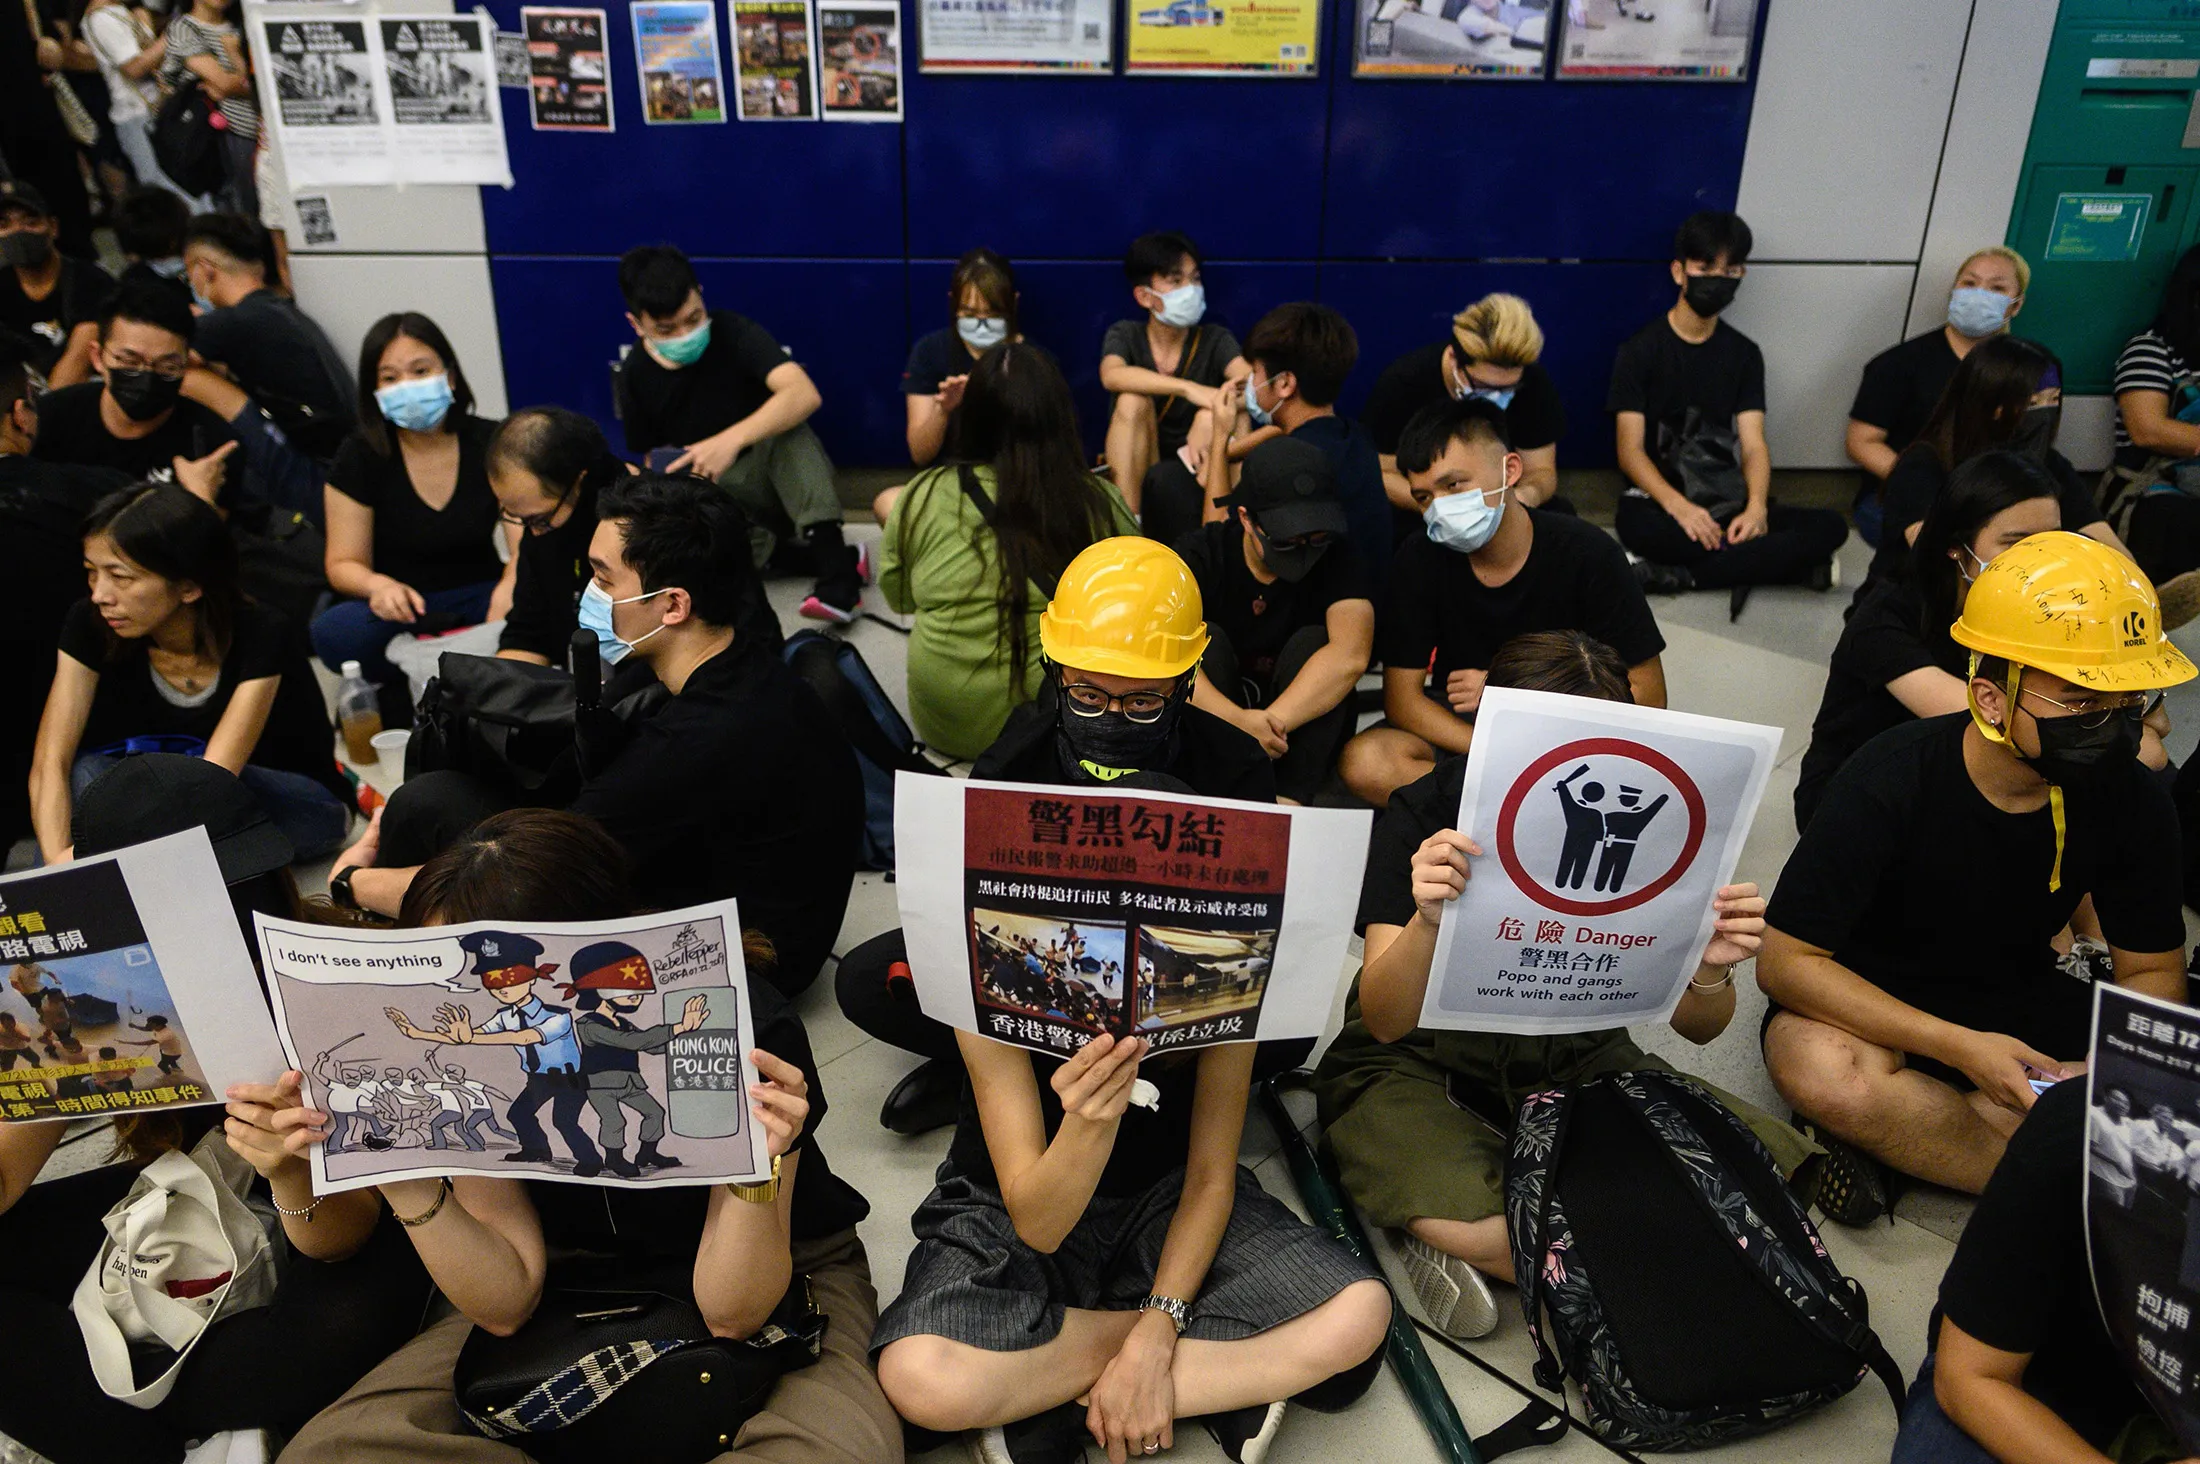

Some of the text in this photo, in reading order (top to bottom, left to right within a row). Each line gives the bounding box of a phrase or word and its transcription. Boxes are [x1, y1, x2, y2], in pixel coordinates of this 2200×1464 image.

[1028, 799, 1225, 859] 警黑勾結
[989, 848, 1270, 886] 市民報警求助超過一小時未有處理
[977, 879, 1268, 917] 黑社會持棍追打市民 多名記者及示威者受傷
[0, 929, 88, 959] 路電視
[1575, 927, 1658, 950] Danger
[278, 948, 443, 970] I don't see anything
[1519, 947, 1621, 972] 警黑合作
[1497, 969, 1623, 988] Popo and gangs
[1477, 986, 1639, 1001] work with each other
[669, 1037, 708, 1056] HONG
[2106, 1034, 2135, 1051] Days
[2136, 1045, 2165, 1062] from
[673, 1057, 736, 1075] POLICE
[2137, 1283, 2190, 1330] 拘捕
